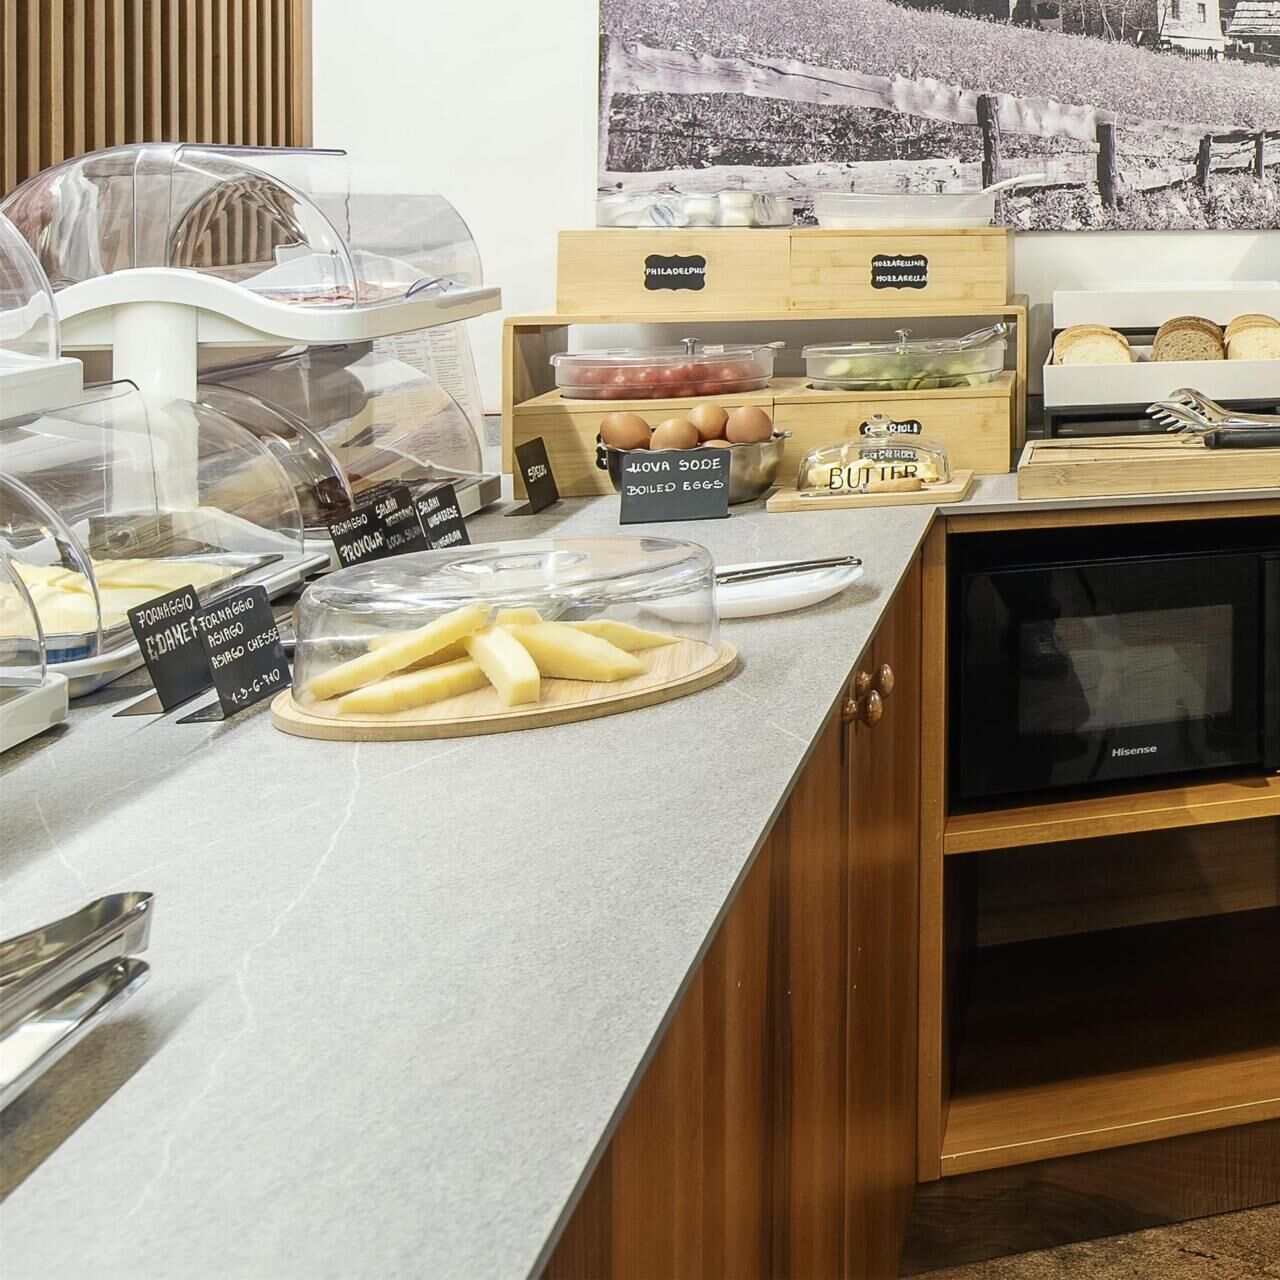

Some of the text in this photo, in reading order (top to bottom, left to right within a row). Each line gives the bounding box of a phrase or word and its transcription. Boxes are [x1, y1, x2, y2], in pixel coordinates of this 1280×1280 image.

[679, 458, 722, 471] SODE
[626, 480, 724, 496] BOILED EGGS
[208, 622, 244, 648] ASIAGO
[211, 627, 280, 669] ASIAGO CHESSE
[1112, 745, 1157, 757] Hisense
